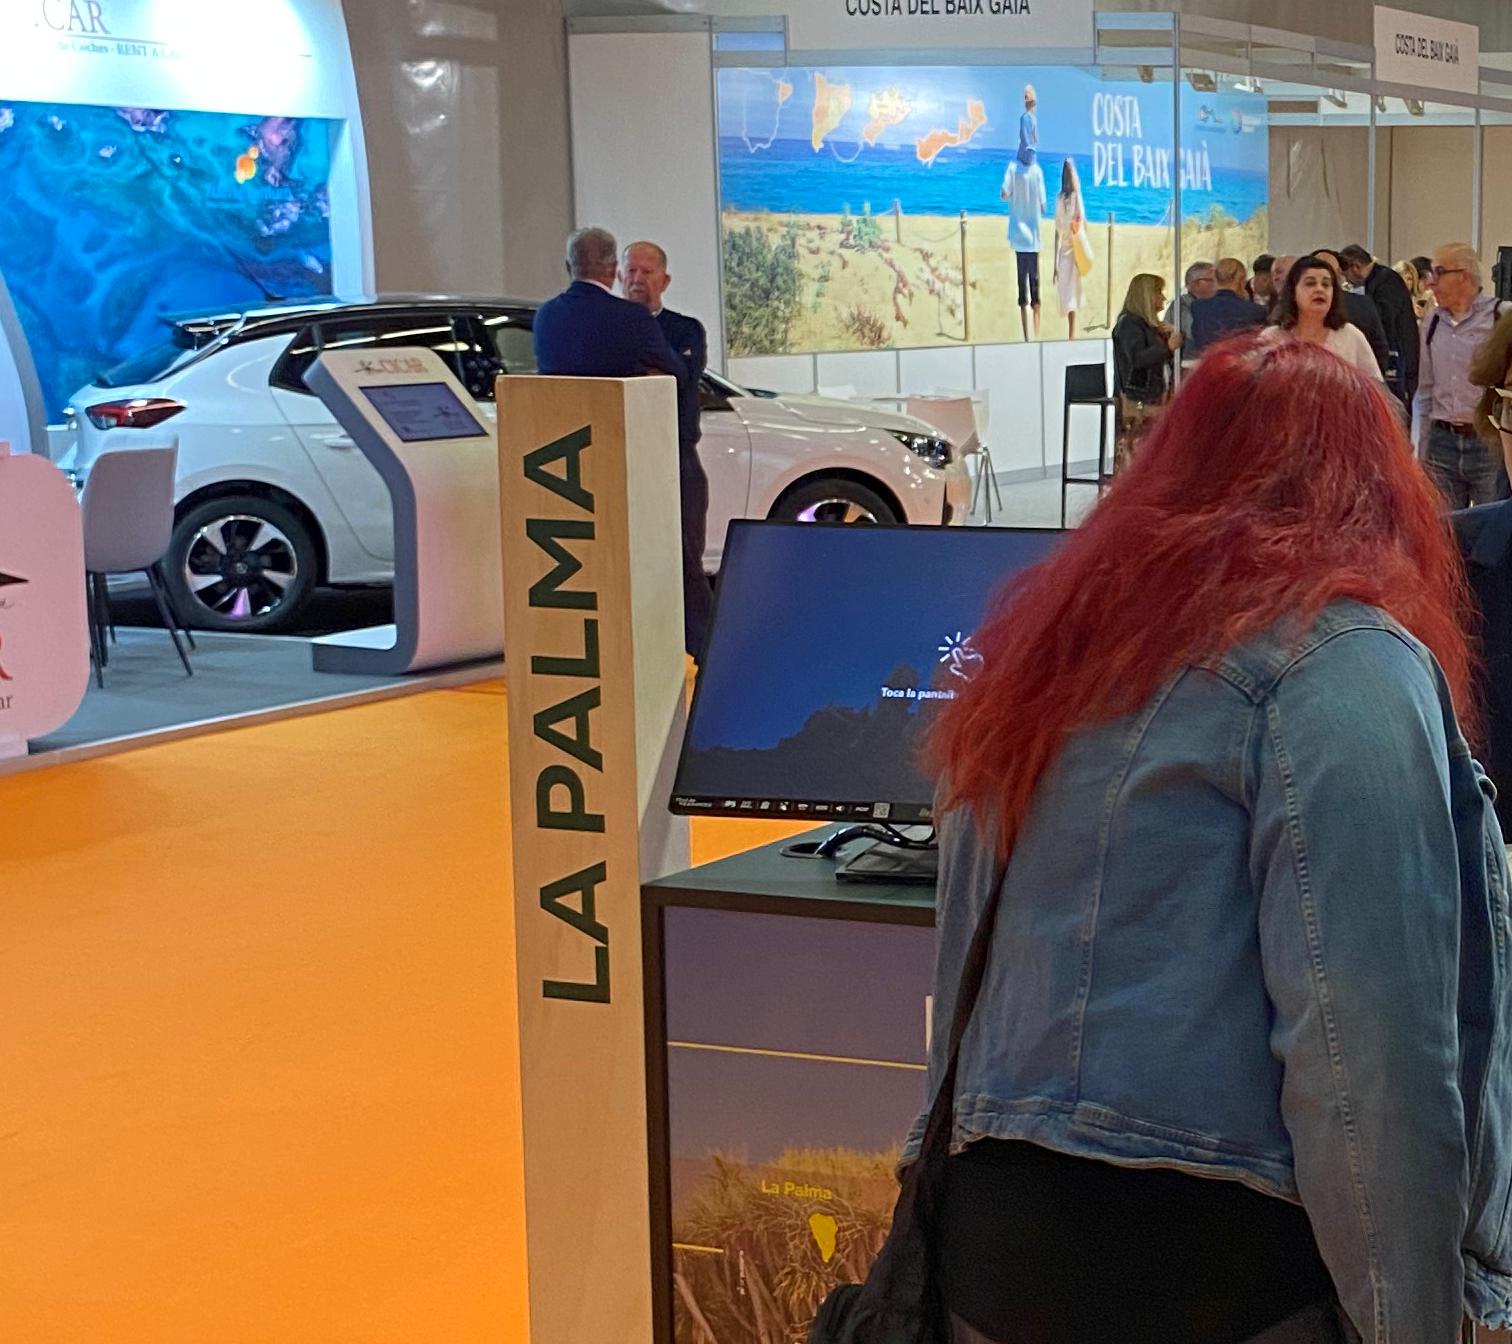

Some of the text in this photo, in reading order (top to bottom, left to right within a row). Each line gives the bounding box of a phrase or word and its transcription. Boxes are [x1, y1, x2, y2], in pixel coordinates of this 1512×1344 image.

[1092, 92, 1143, 138] COSTA
[1093, 141, 1128, 187] DEL
[1132, 144, 1172, 189] BAIX
[523, 424, 611, 1005] LA PALMA
[881, 687, 905, 698] Toca
[761, 1179, 833, 1200] La Palma
